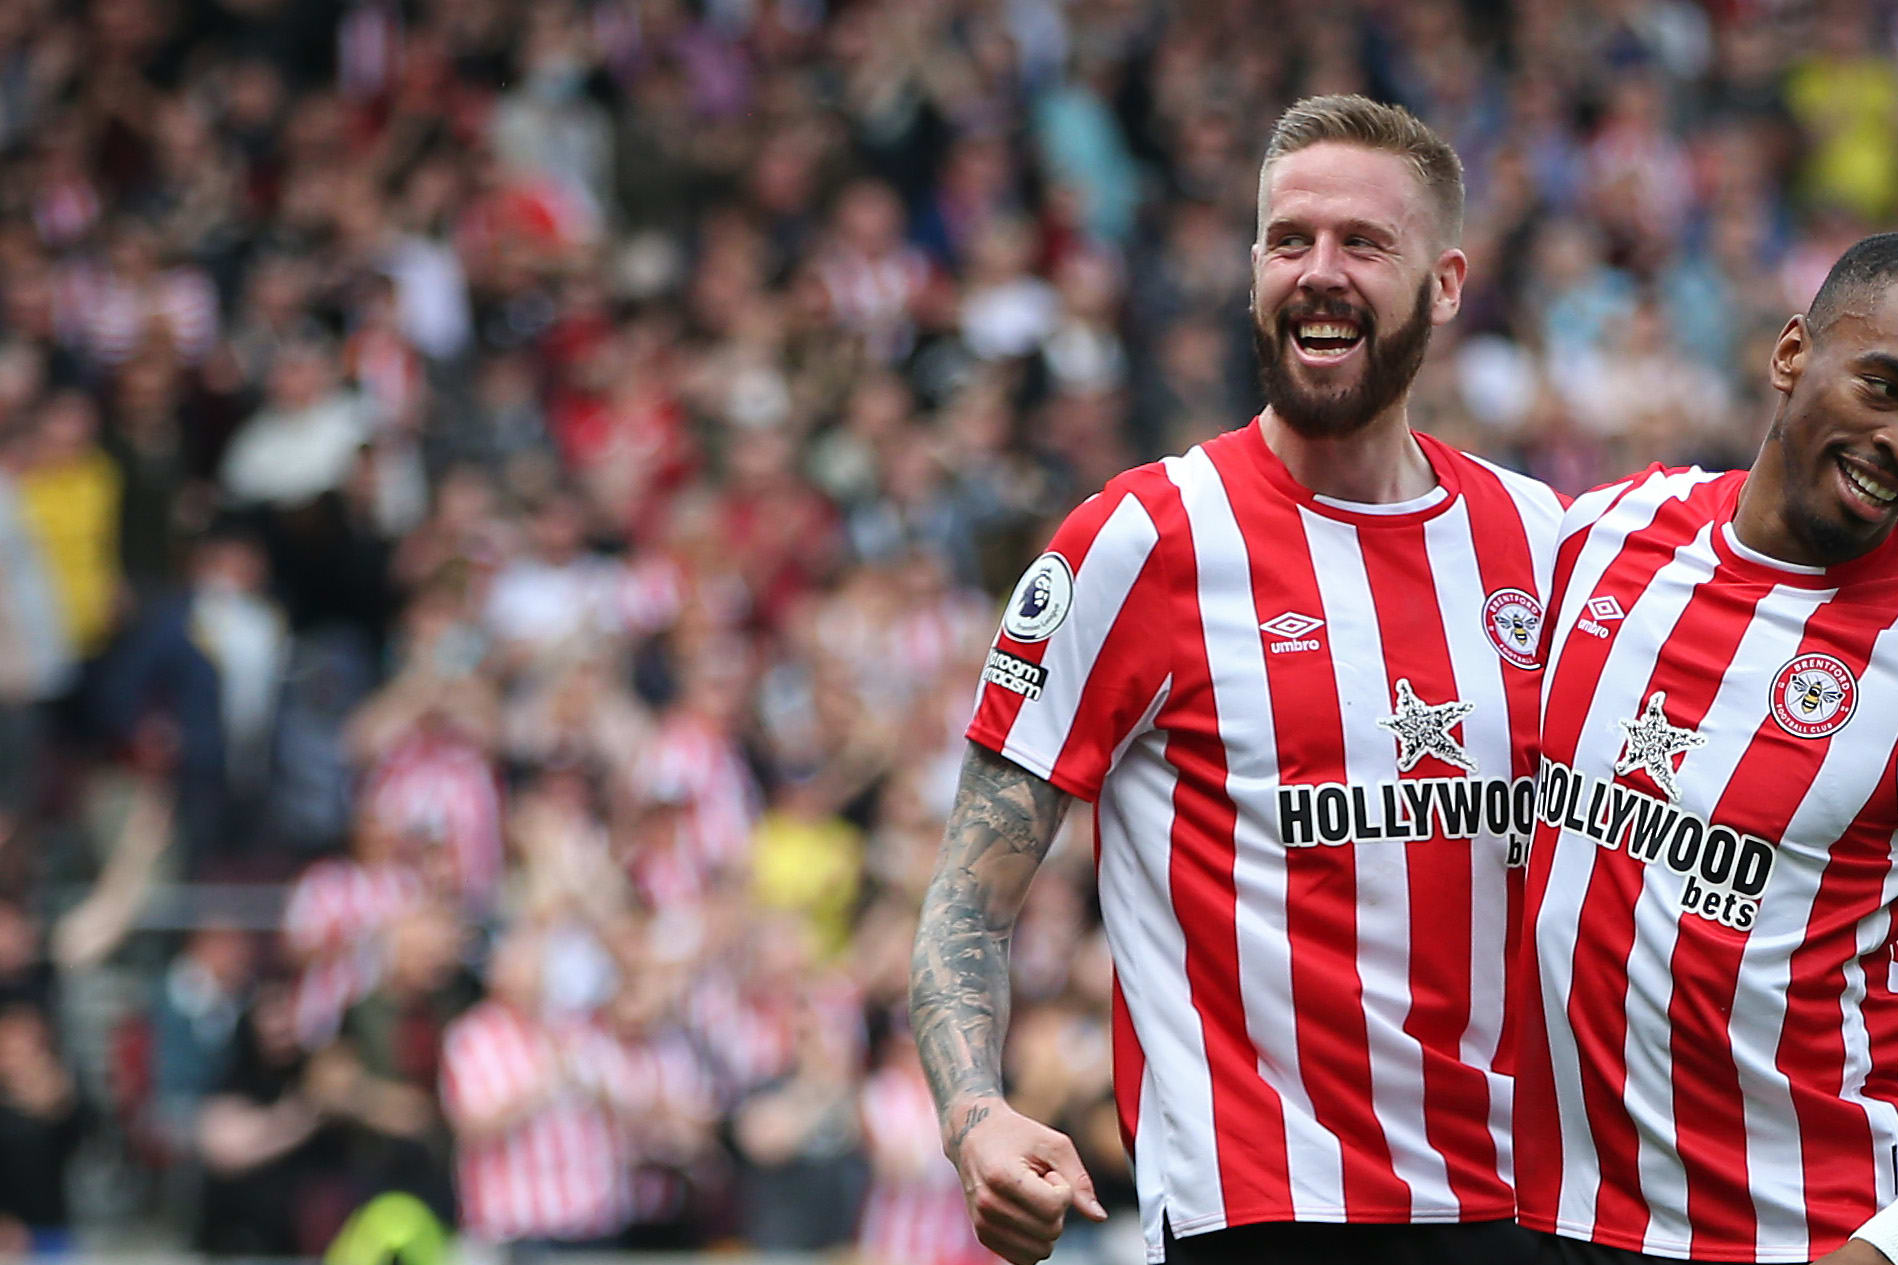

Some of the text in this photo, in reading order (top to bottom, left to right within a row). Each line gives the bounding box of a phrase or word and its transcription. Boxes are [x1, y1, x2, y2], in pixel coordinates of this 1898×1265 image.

[1576, 618, 1609, 639] umbro
[1270, 638, 1320, 654] umbro
[1793, 659, 1851, 691] BRENTFORD
[1776, 703, 1833, 734] FOOTBALL CLUB
[1279, 779, 1534, 845] HOLLYWOO
[1539, 759, 1774, 897] HOLLYWOOD
[1680, 875, 1757, 928] bets
